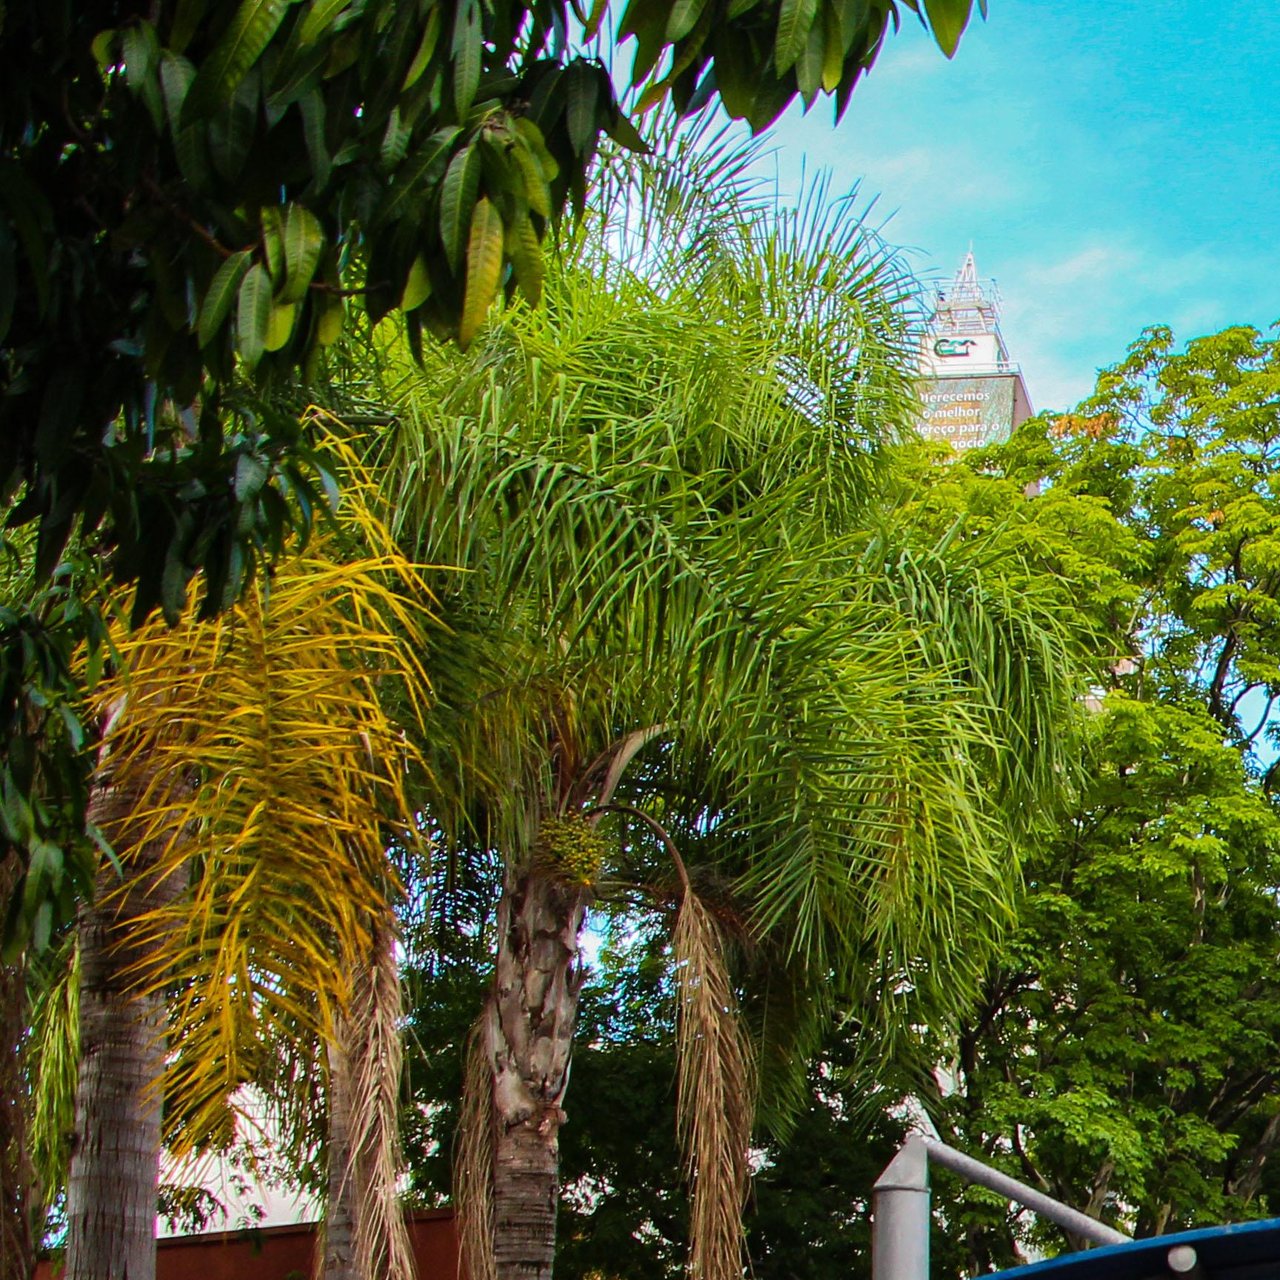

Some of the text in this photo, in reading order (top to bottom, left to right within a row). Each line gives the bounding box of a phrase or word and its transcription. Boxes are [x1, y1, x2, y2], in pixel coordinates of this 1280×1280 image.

[922, 406, 981, 419] o melhor
[960, 423, 987, 435] para
[991, 422, 1000, 432] o
